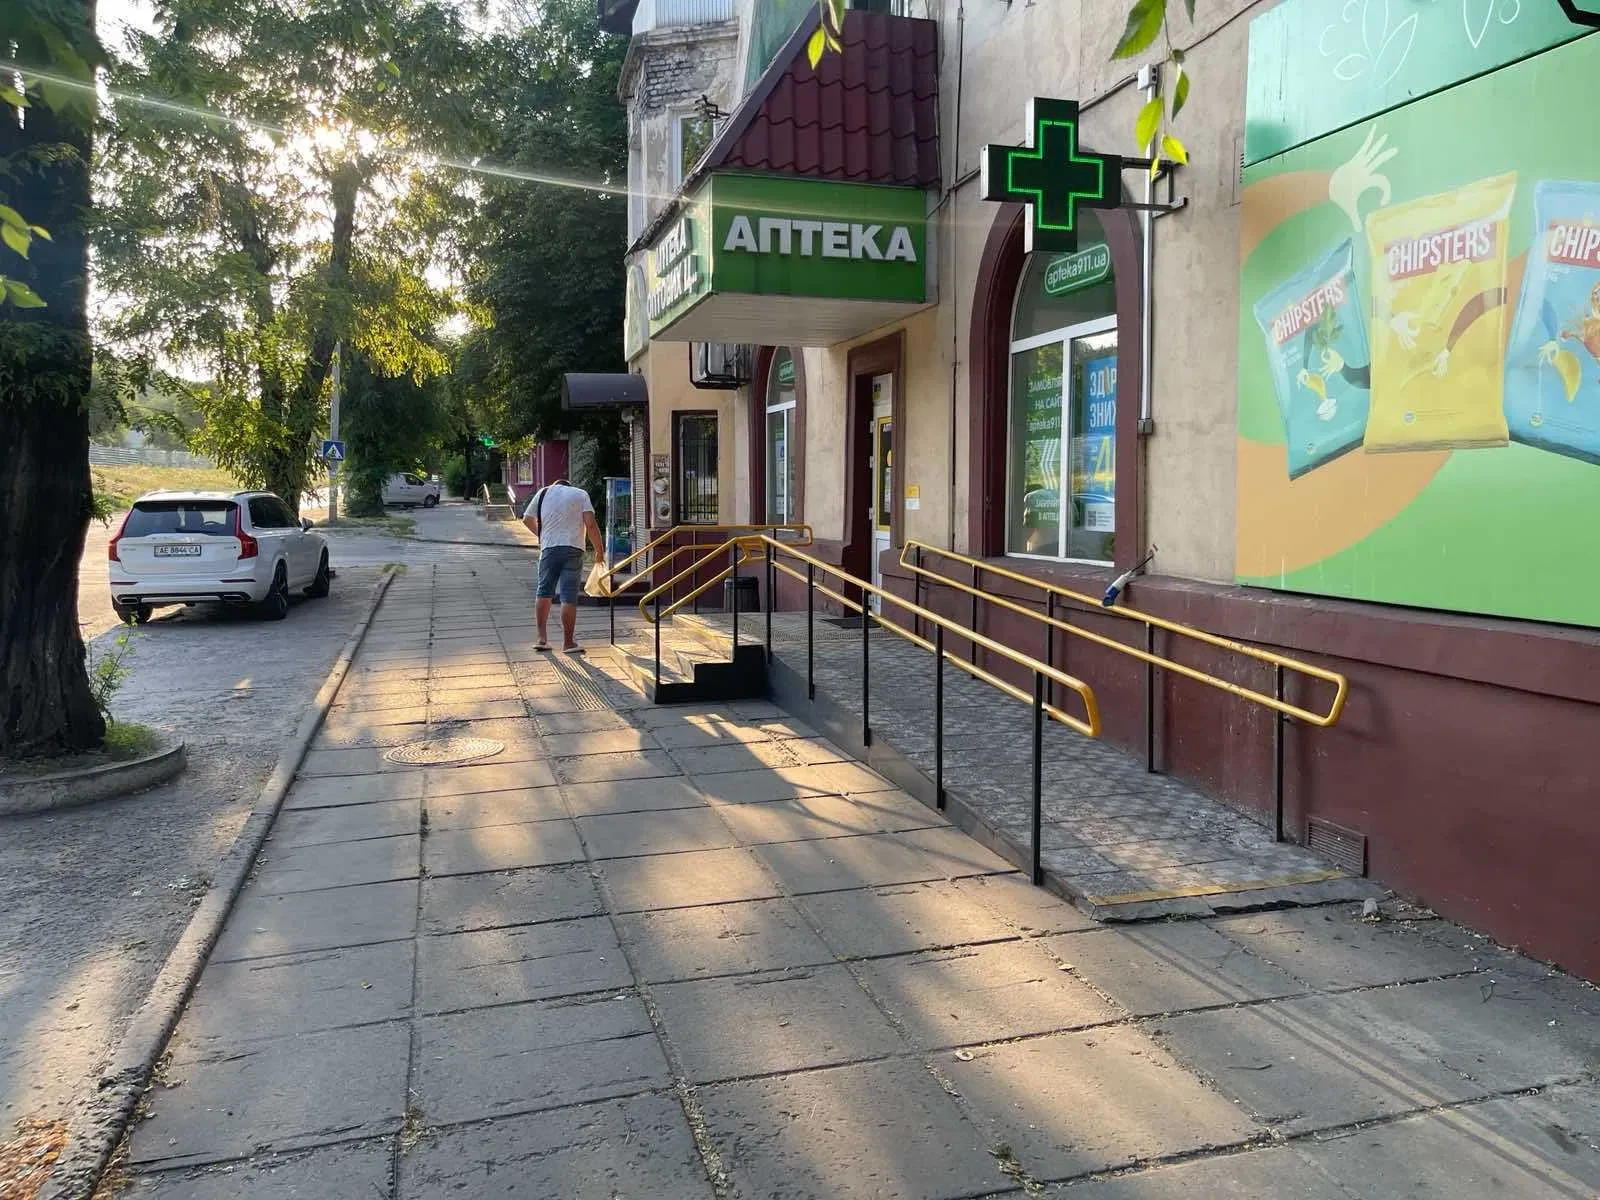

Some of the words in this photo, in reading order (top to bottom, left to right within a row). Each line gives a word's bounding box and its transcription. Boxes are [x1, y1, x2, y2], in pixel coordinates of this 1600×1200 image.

[723, 215, 917, 262] АПТЕКА
[1388, 223, 1491, 276] CHIPSTERS
[1047, 252, 1107, 289] apteka911.ua
[1273, 279, 1344, 341] CHIPSTERS
